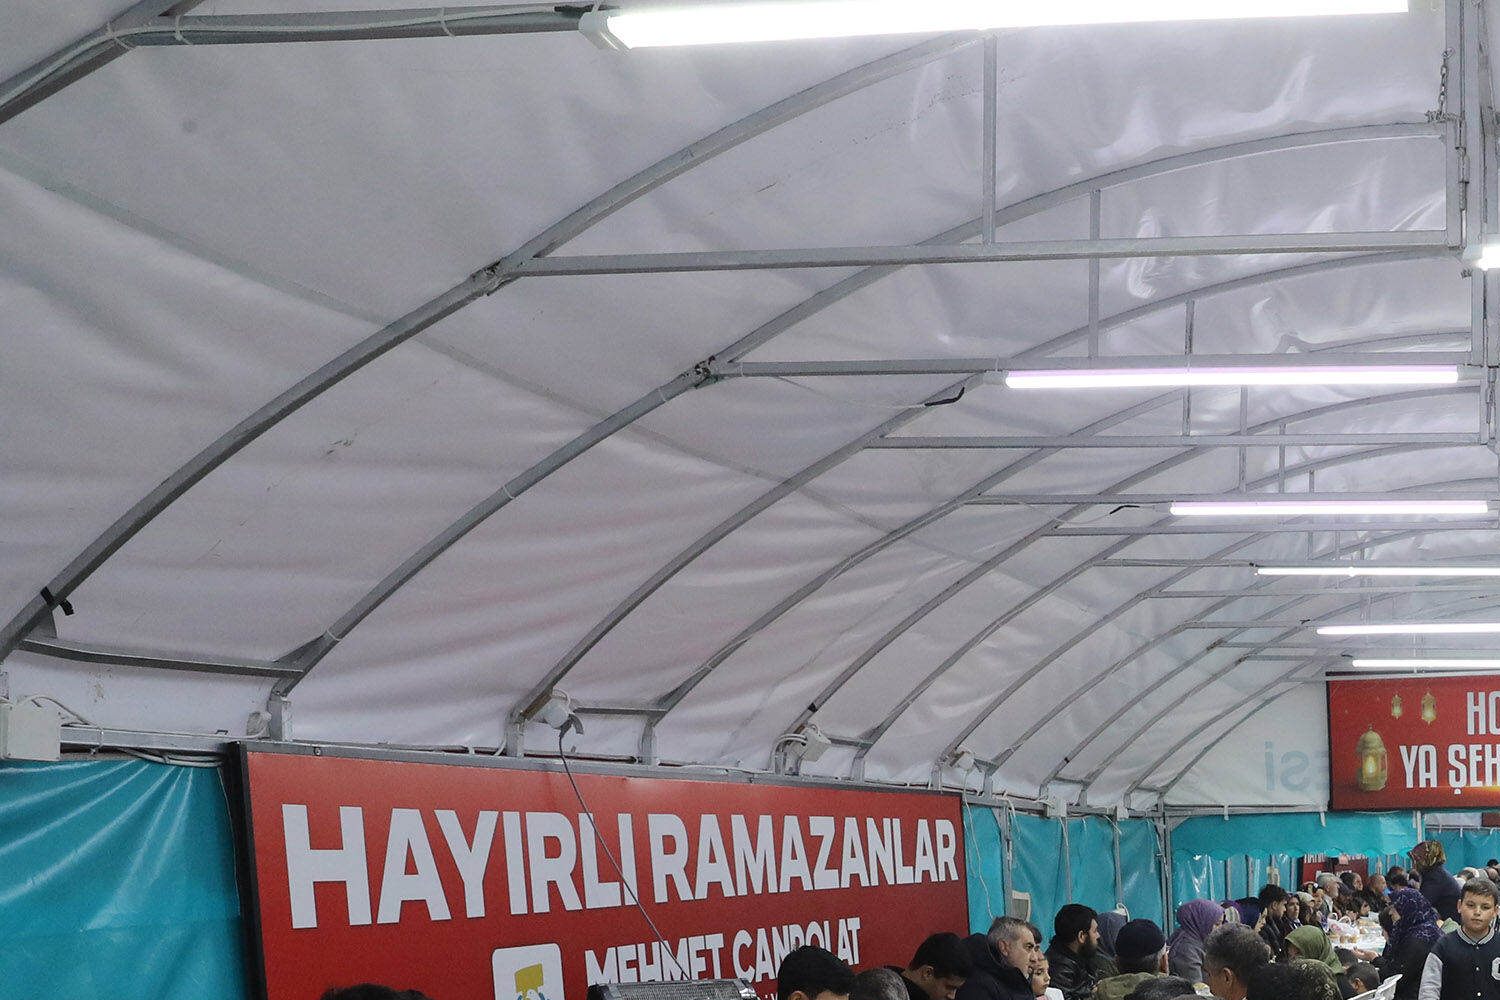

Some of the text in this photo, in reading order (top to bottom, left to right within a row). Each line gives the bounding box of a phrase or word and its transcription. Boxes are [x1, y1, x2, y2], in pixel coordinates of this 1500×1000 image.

[1399, 745, 1438, 788] YA
[282, 803, 959, 930] HAYIRLI RAMAZANLAR
